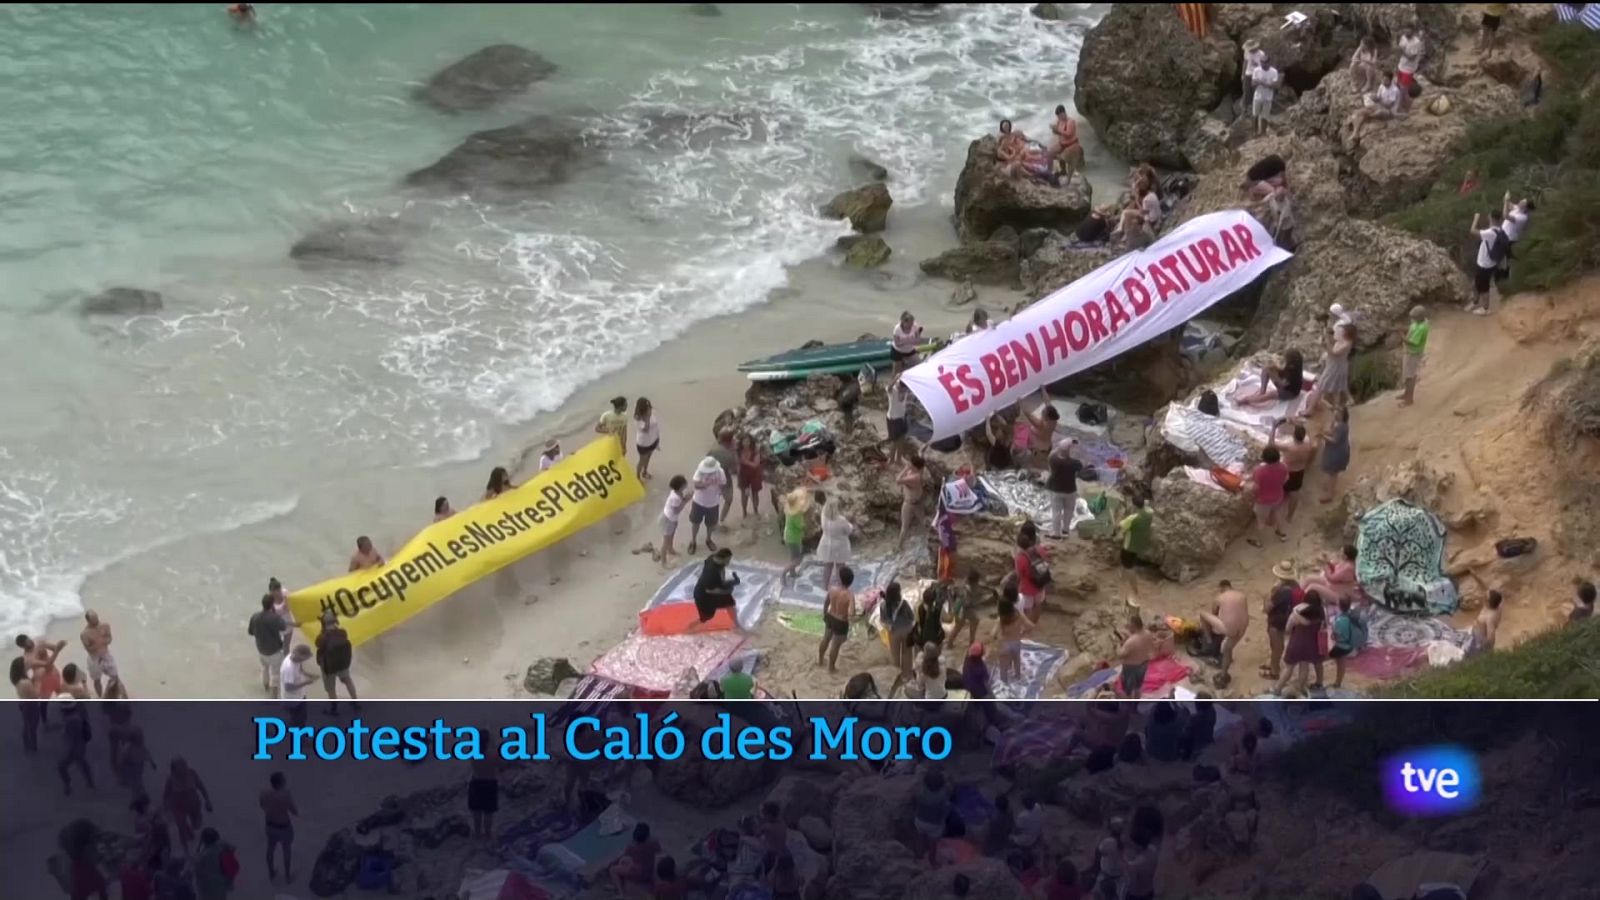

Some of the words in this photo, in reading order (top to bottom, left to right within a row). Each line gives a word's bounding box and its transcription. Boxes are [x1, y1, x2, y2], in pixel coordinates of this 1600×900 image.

[938, 364, 986, 414] ÉS
[980, 333, 1043, 396] BEN
[1040, 291, 1131, 366] HORA
[1124, 223, 1261, 317] D'ATURAR
[319, 459, 622, 620] #OcupemLesNostresPlatges
